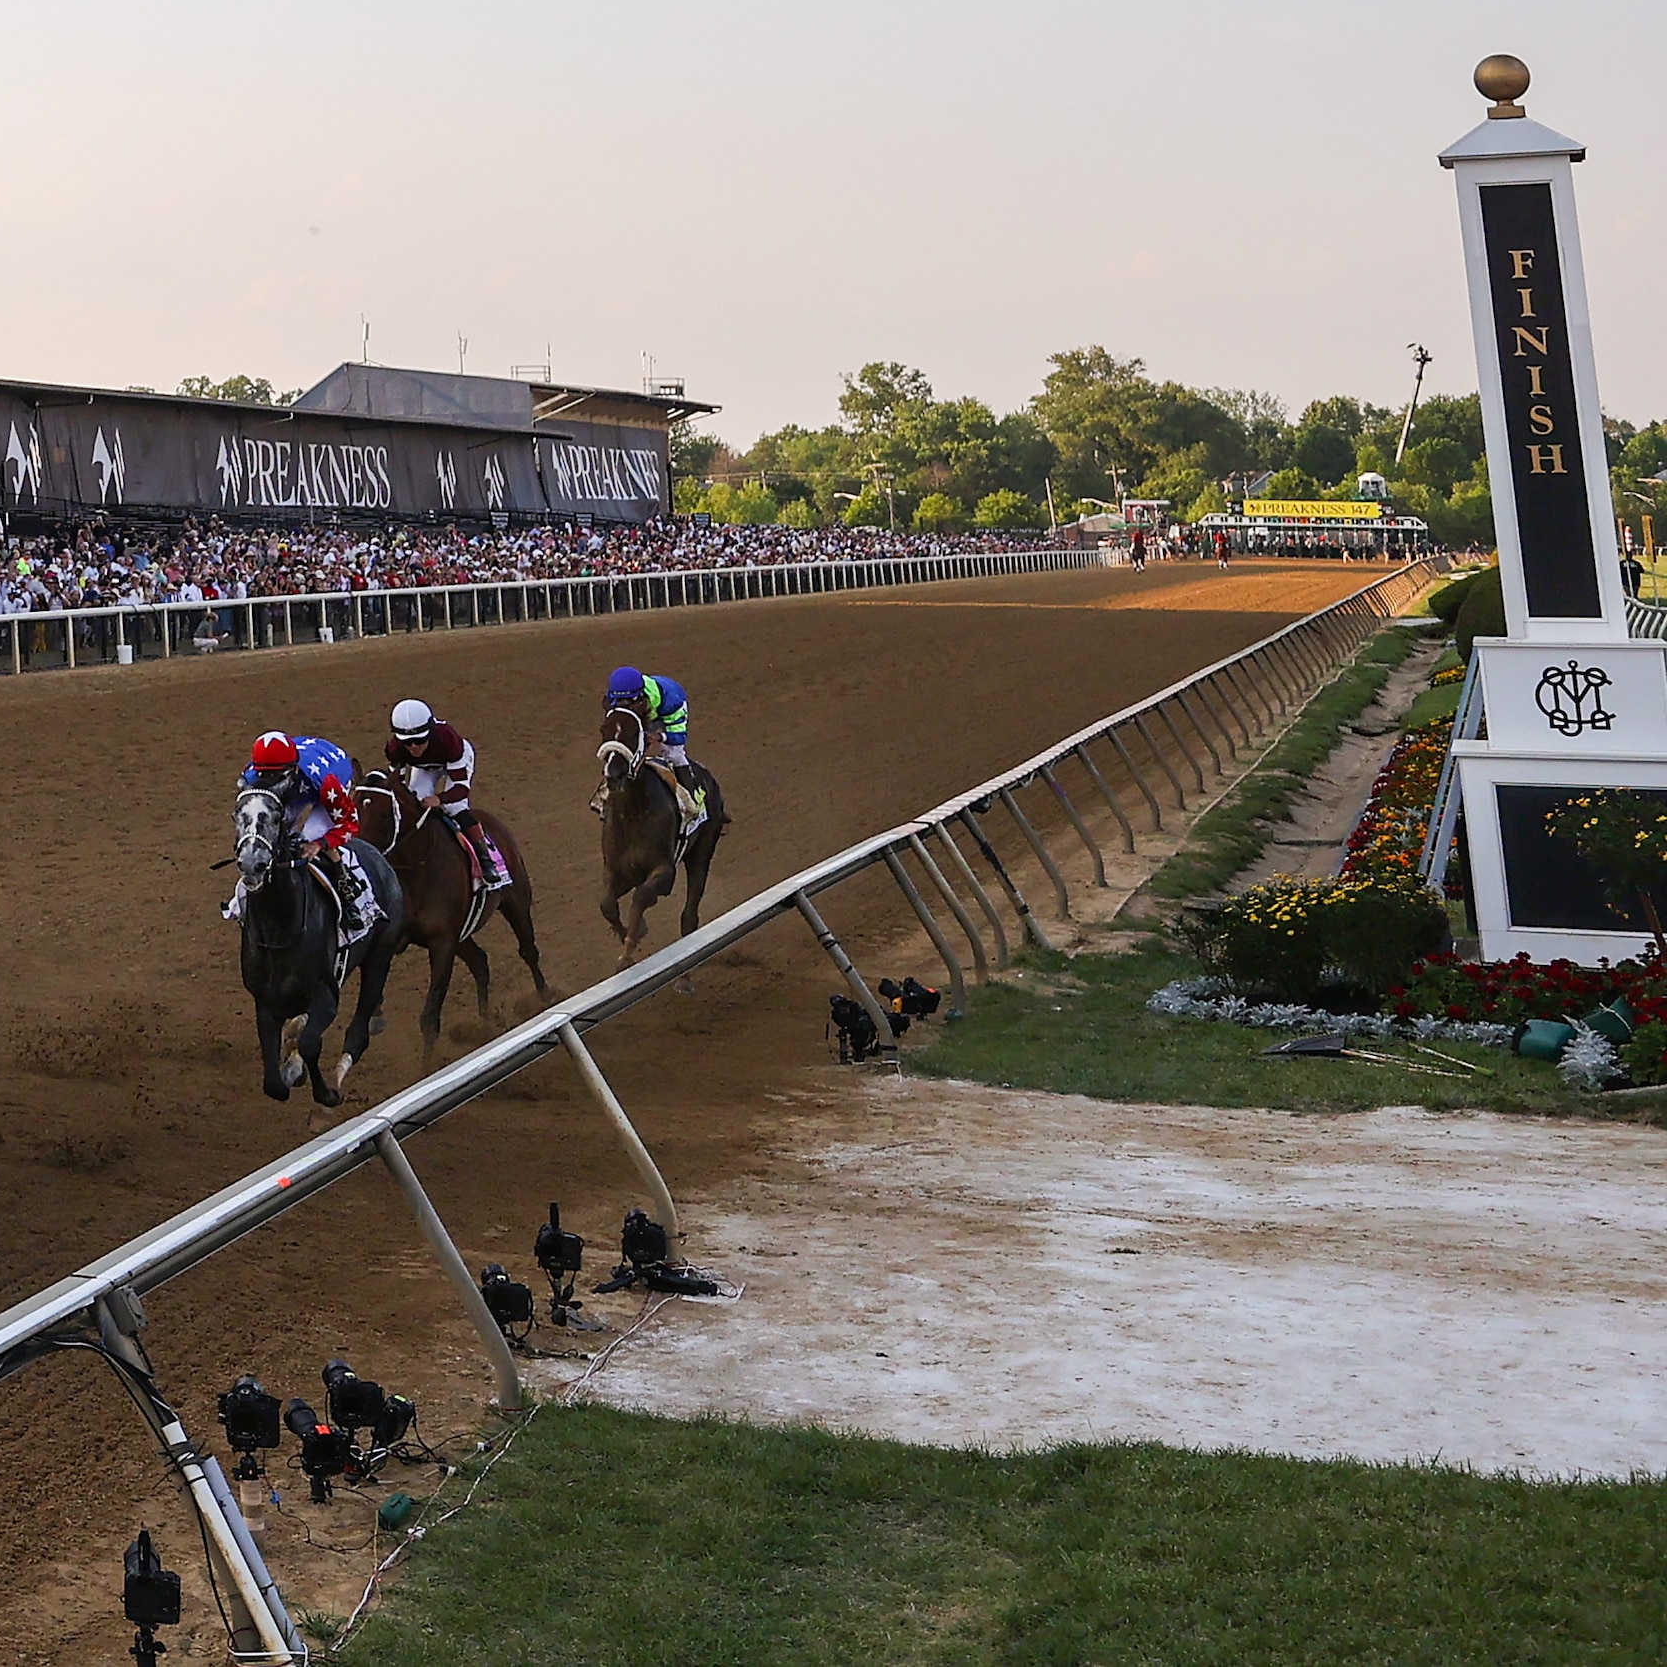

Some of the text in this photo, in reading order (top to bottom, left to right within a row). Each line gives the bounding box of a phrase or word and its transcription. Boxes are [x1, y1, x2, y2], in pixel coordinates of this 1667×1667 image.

[1507, 248, 1568, 474] FINISH
[244, 438, 391, 508] PREAKNESS
[1263, 504, 1346, 515] PREAKNESS
[1351, 505, 1371, 515] 147
